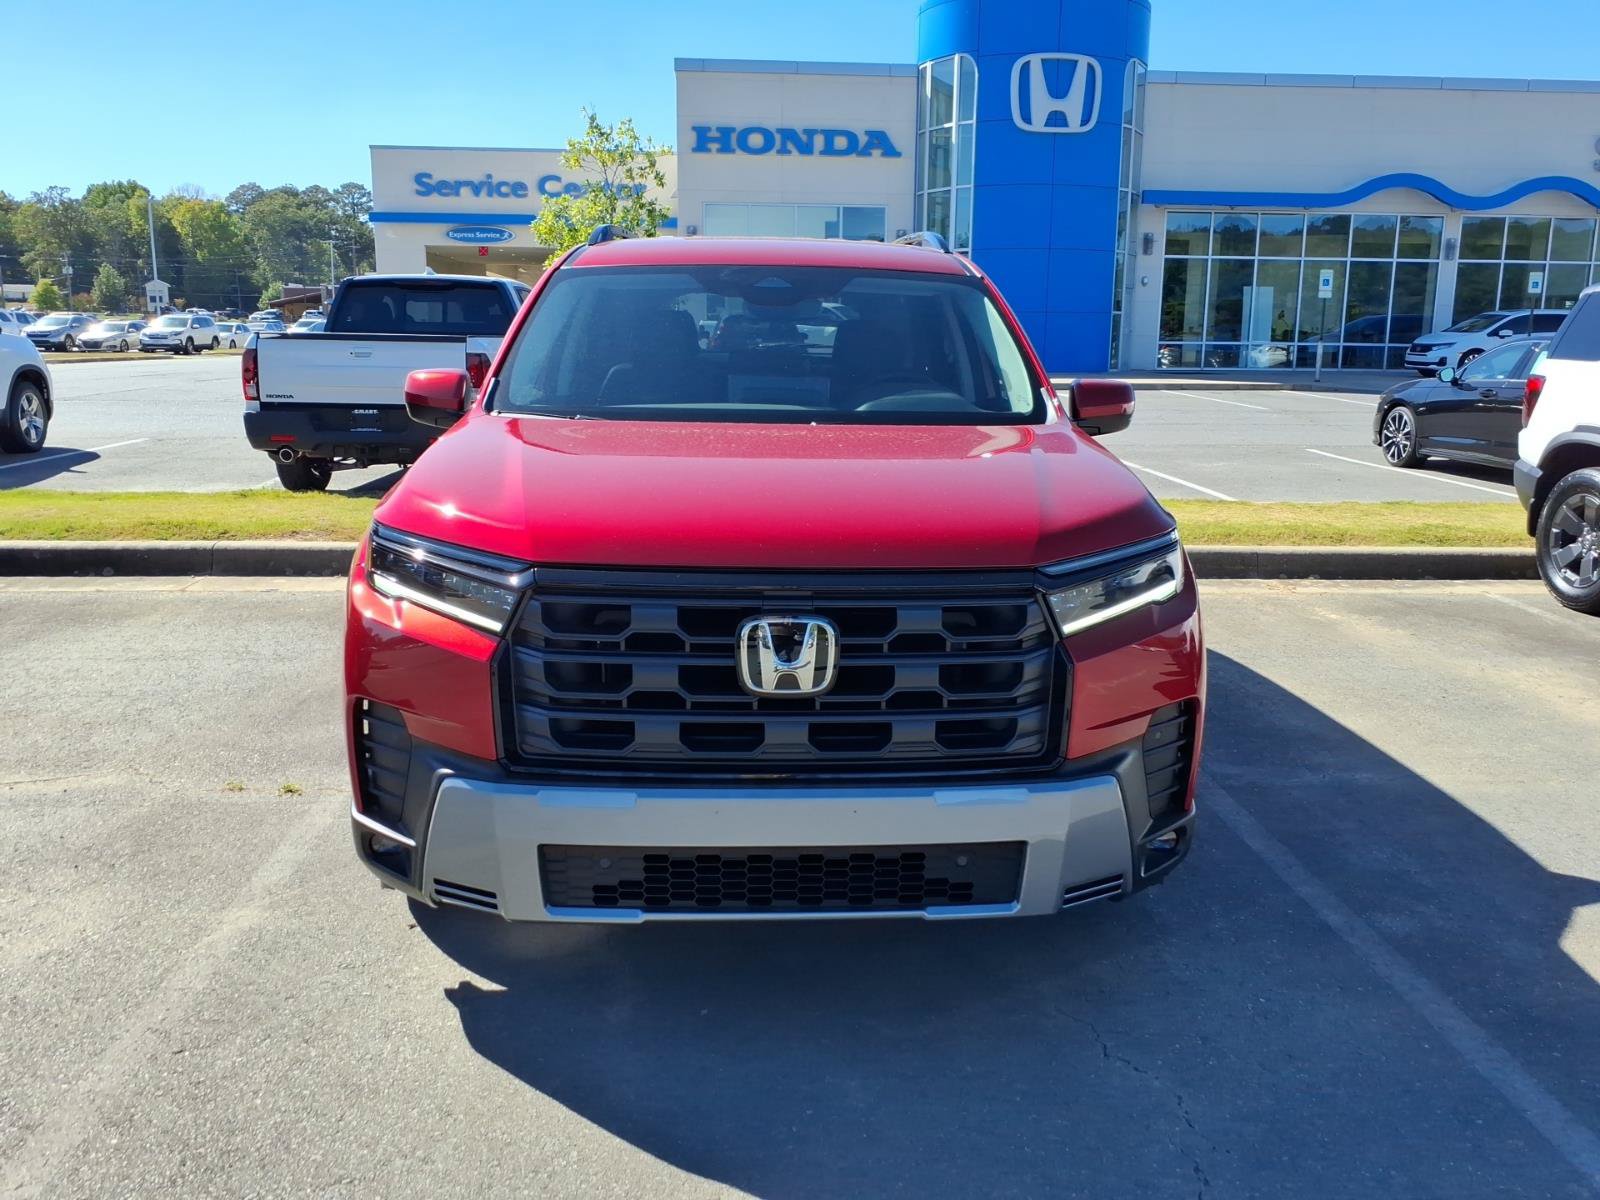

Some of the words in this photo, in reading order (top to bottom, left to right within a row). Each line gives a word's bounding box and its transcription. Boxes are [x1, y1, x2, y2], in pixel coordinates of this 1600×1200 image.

[691, 126, 903, 158] HONDA
[413, 172, 529, 198] Service
[449, 231, 474, 239] Express
